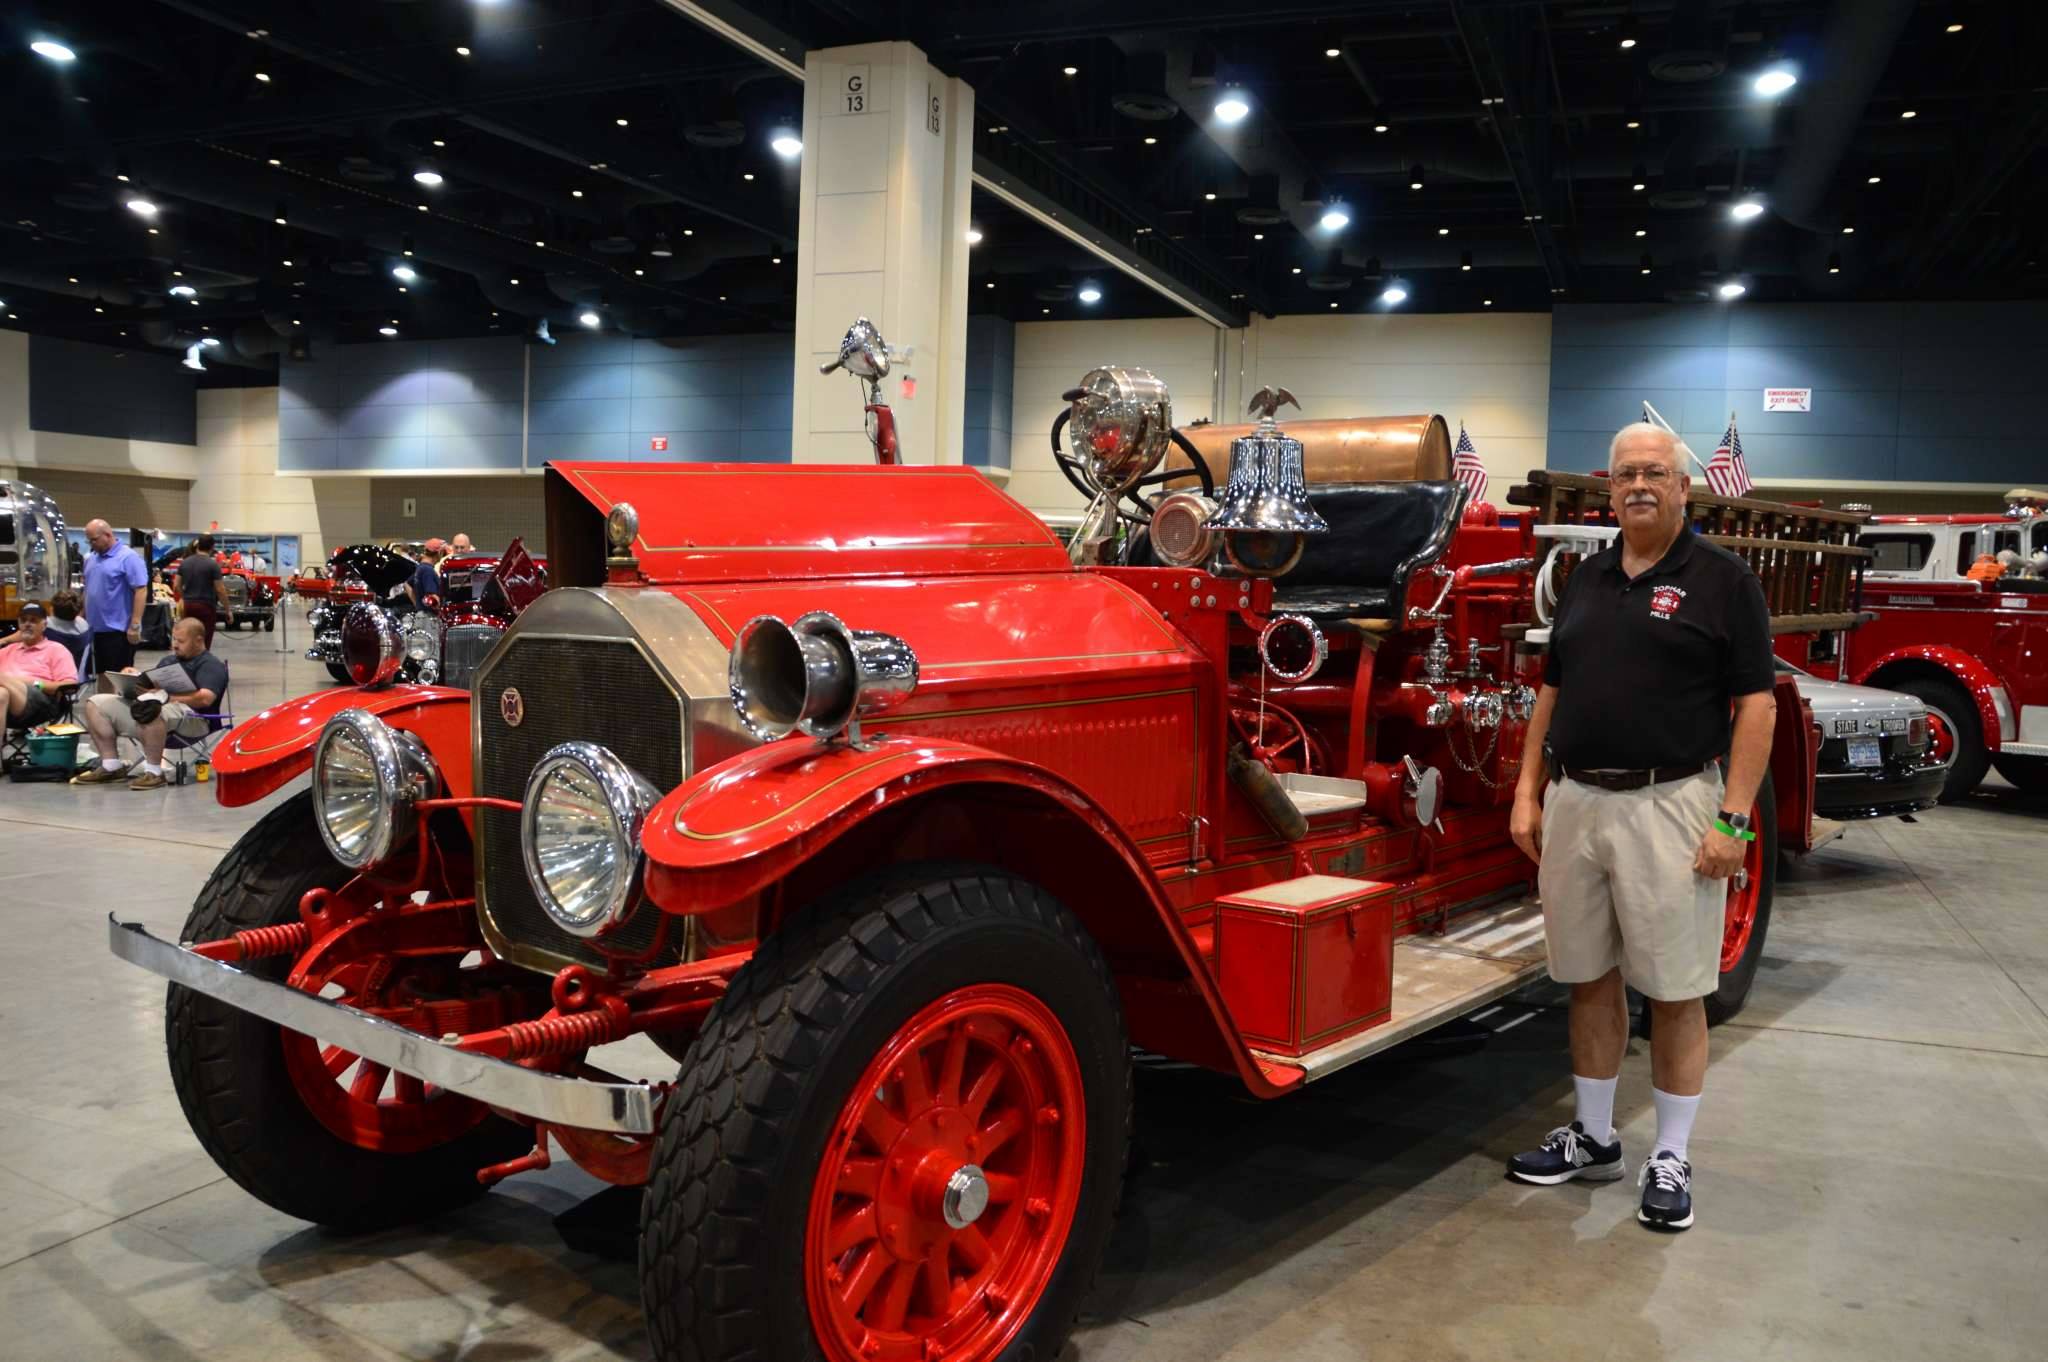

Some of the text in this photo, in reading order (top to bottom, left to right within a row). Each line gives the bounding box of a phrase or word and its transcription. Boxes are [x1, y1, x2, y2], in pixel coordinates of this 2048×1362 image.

[847, 76, 863, 92] G
[847, 96, 863, 112] 13
[932, 97, 940, 113] G
[931, 115, 940, 133] 13
[1650, 611, 1670, 620] MILLS
[1836, 721, 1857, 732] STATE
